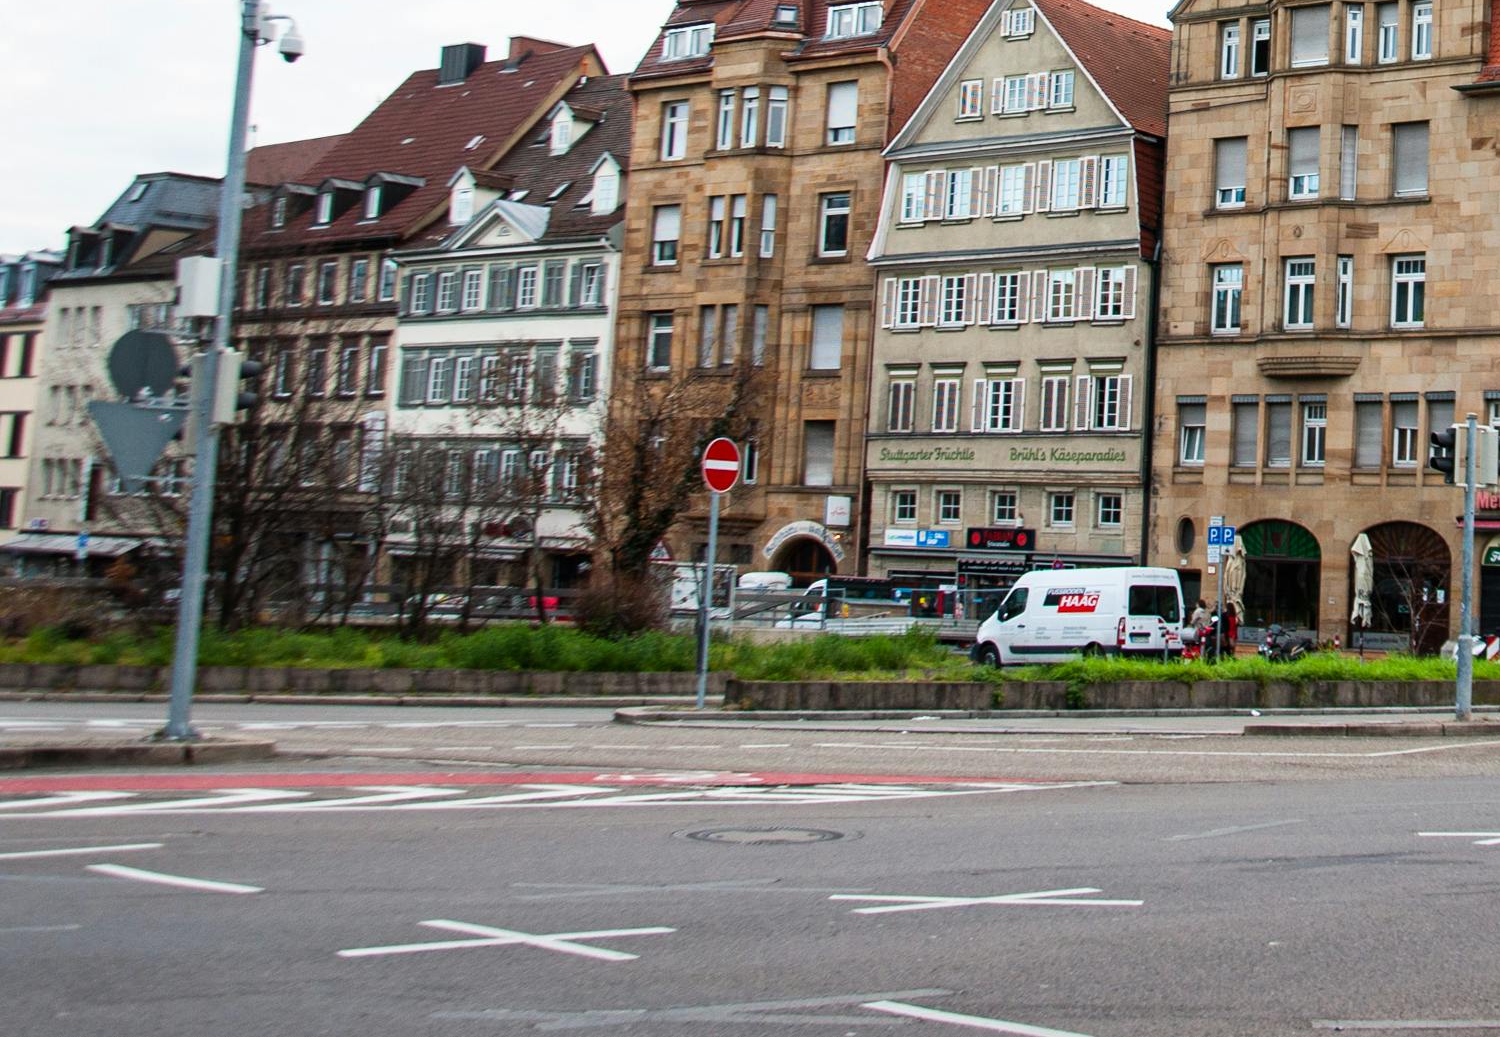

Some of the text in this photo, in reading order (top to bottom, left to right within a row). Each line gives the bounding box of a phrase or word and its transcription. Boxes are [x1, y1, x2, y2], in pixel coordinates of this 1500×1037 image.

[880, 447, 975, 463] Stuttgarter Früchtle
[1009, 448, 1126, 464] Brühl's Käseparadies
[1210, 528, 1218, 542] P
[1223, 528, 1232, 543] P
[1060, 595, 1098, 607] HAAG
